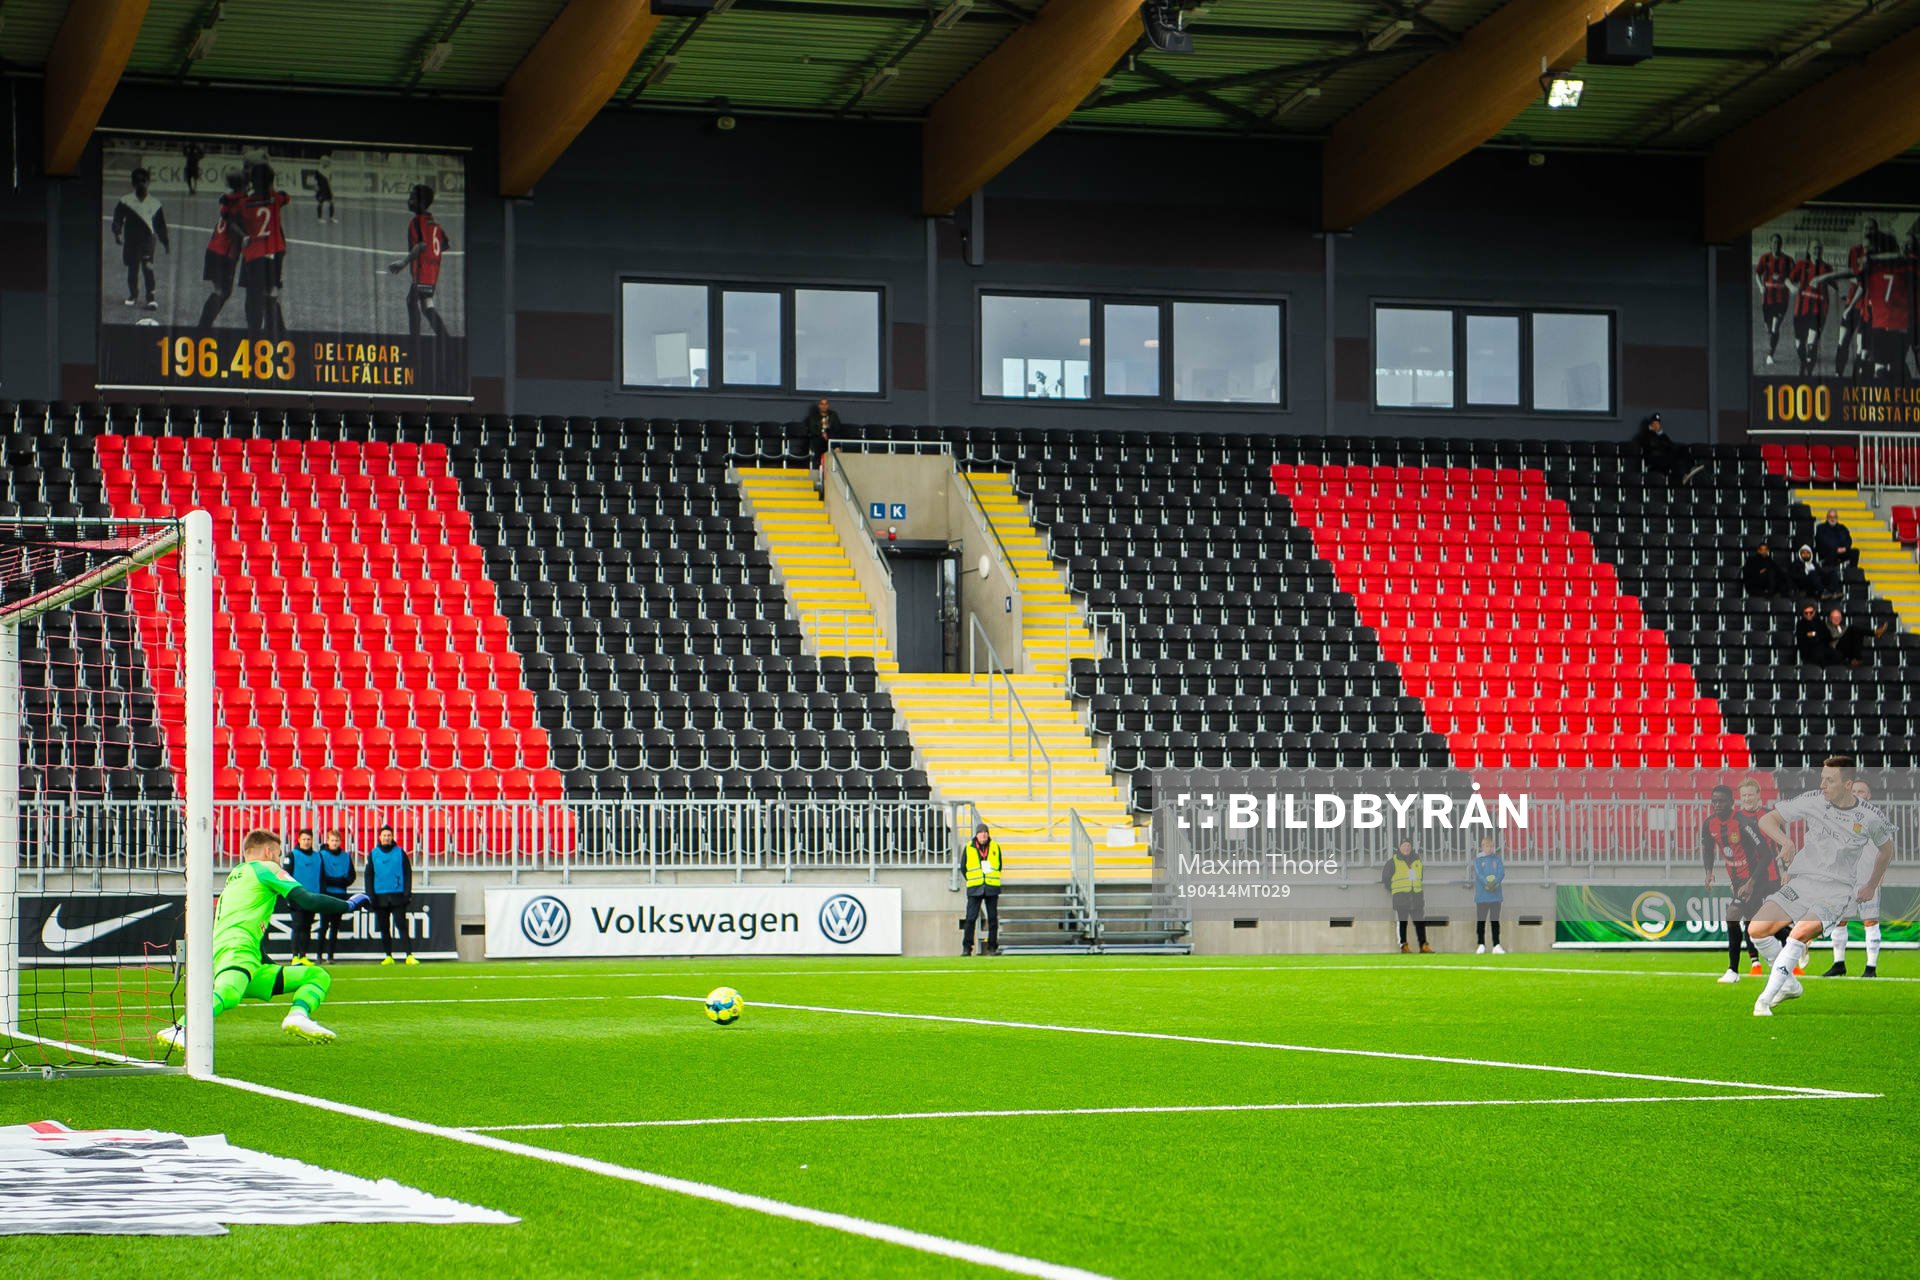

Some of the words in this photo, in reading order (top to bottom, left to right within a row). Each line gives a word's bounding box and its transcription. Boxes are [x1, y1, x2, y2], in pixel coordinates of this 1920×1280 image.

[256, 207, 271, 237] 2
[432, 226, 441, 256] 6
[1883, 274, 1895, 302] 7
[156, 335, 296, 380] 196.483
[314, 343, 408, 363] DELTAGAR-
[314, 362, 414, 385] TILLFÄLLEN
[1763, 384, 1831, 421] 1000
[1842, 386, 1891, 403] AKTIVA
[1842, 402, 1902, 422] STÖRSTA
[873, 504, 882, 517] L
[893, 505, 903, 518] K
[592, 906, 799, 940] Volkswagen
